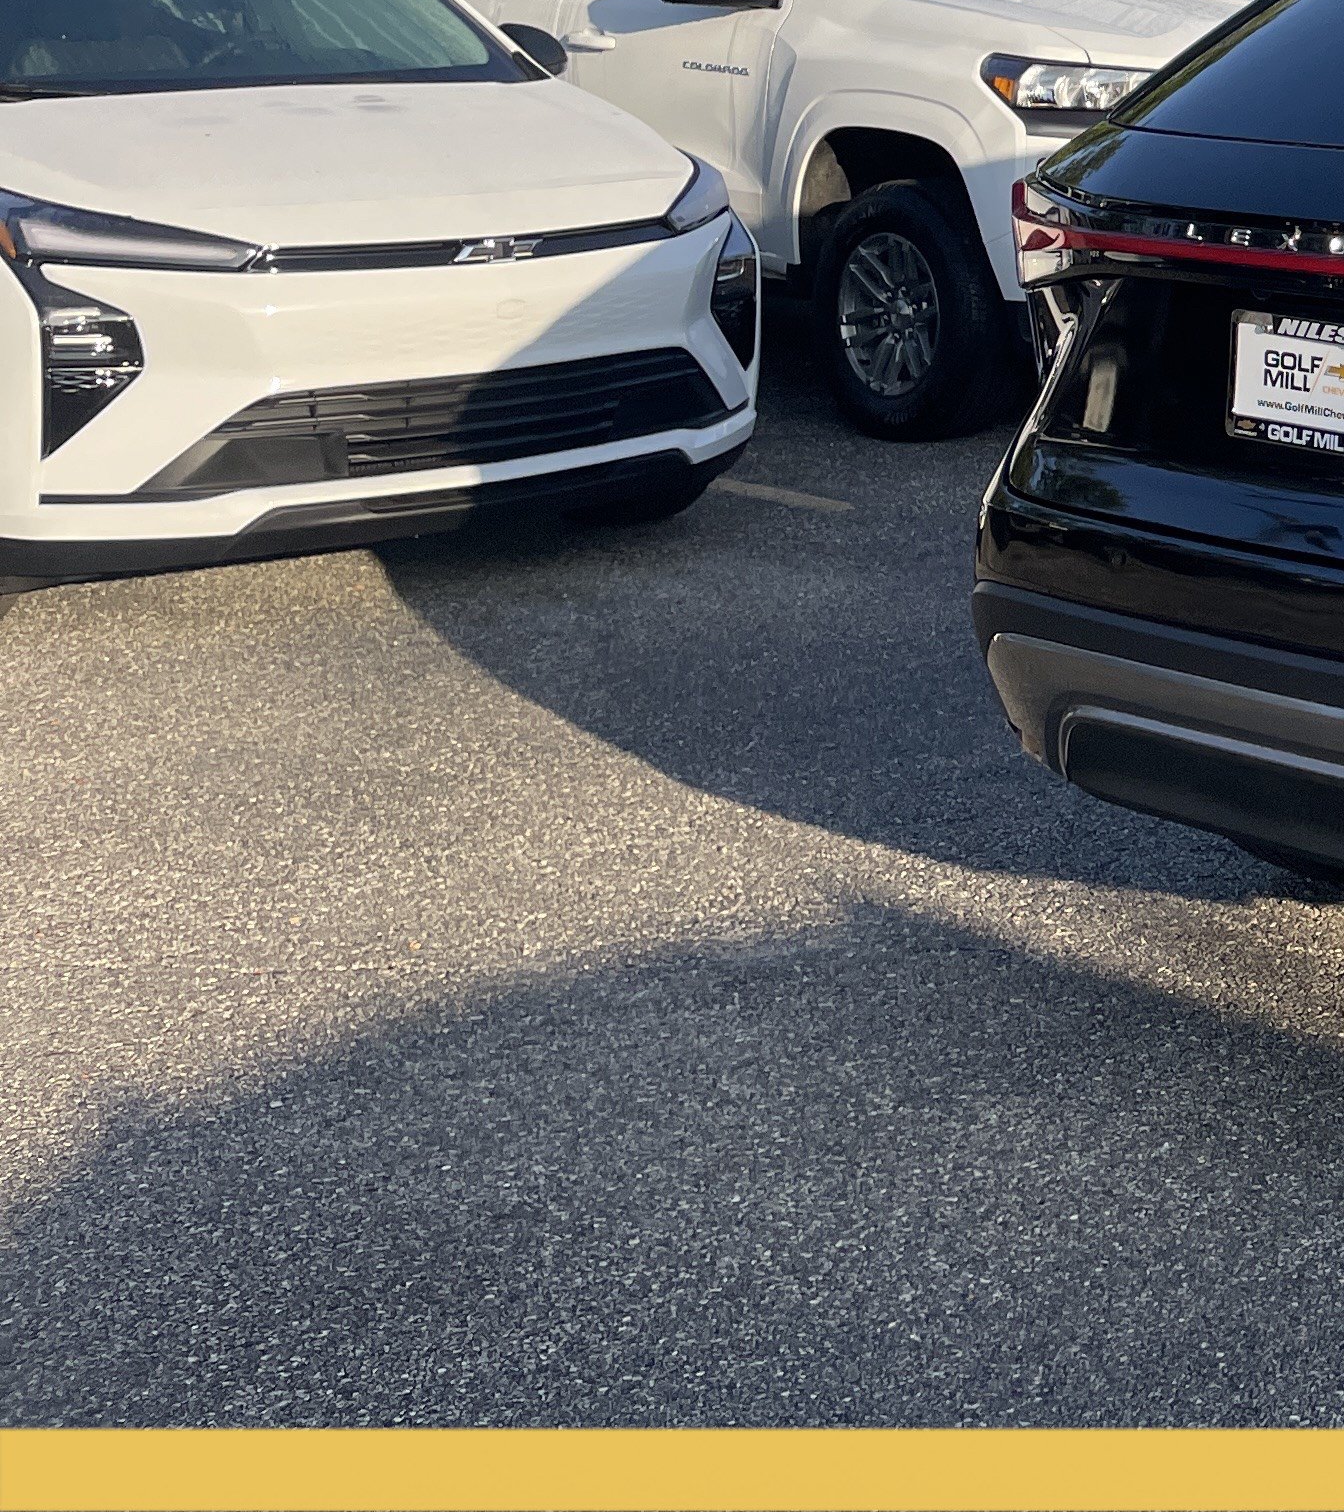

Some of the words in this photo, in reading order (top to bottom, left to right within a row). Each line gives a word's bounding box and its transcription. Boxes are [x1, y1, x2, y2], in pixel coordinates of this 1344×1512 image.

[682, 61, 749, 76] COLORADO
[1264, 349, 1323, 374] GOLF
[1262, 368, 1311, 393] MILL
